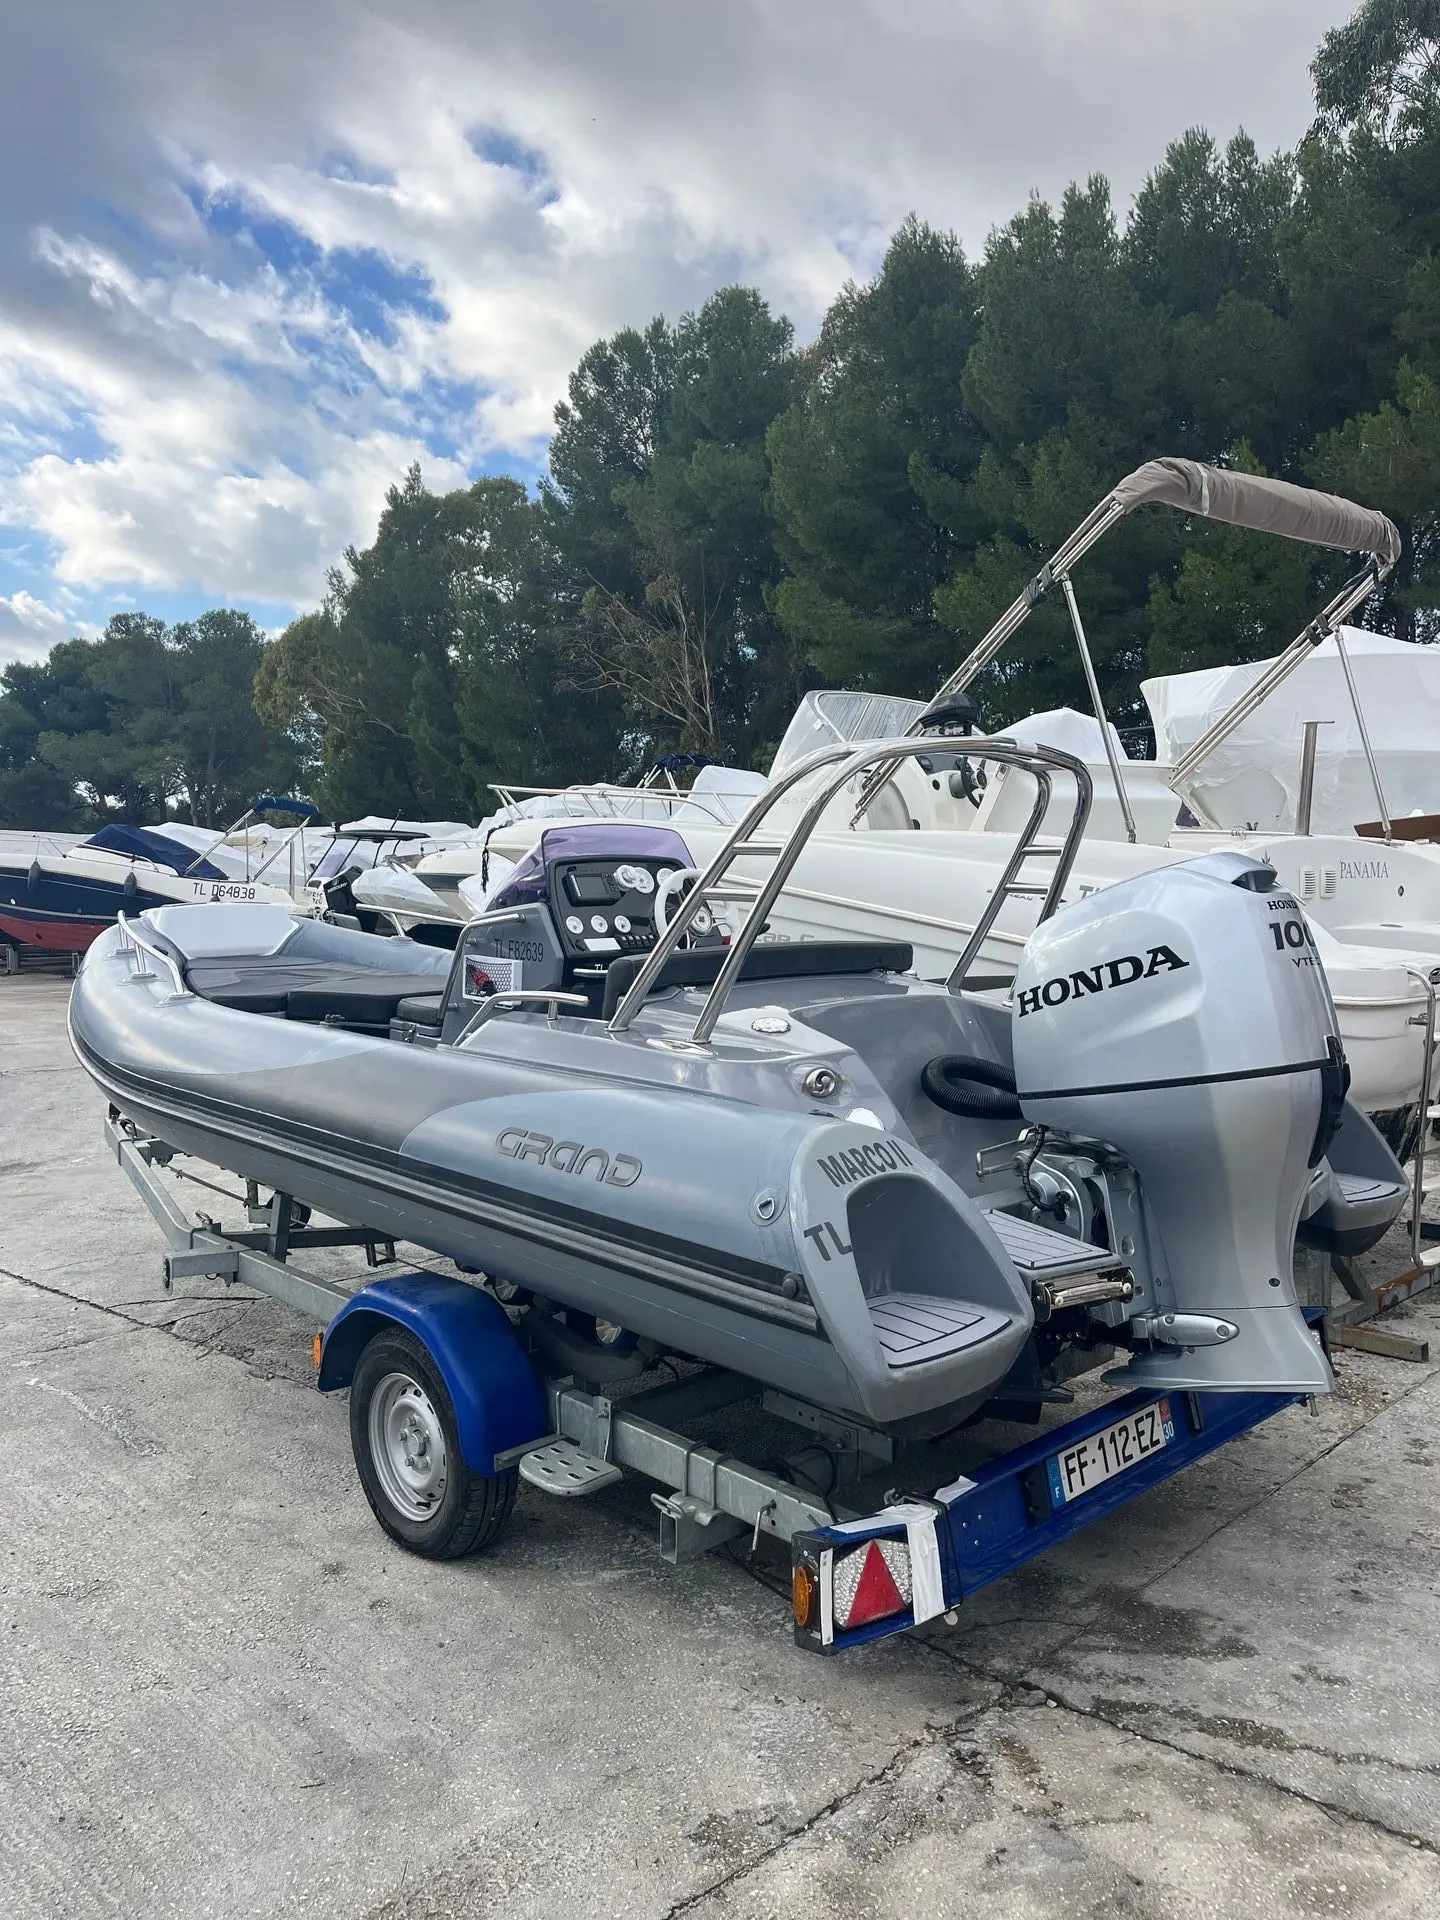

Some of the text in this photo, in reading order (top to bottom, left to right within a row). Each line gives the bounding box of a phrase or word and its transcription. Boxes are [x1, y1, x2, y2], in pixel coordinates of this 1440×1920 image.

[193, 882, 206, 896] TL
[1339, 860, 1389, 879] PANAMA
[494, 938, 544, 963] TL F82639
[1017, 944, 1190, 1018] HONDA
[495, 1126, 643, 1188] GRAND
[817, 1142, 898, 1188] MARCO
[803, 1221, 853, 1262] TL
[1063, 1409, 1161, 1494] FF-112-EZ
[1163, 1420, 1175, 1440] 30
